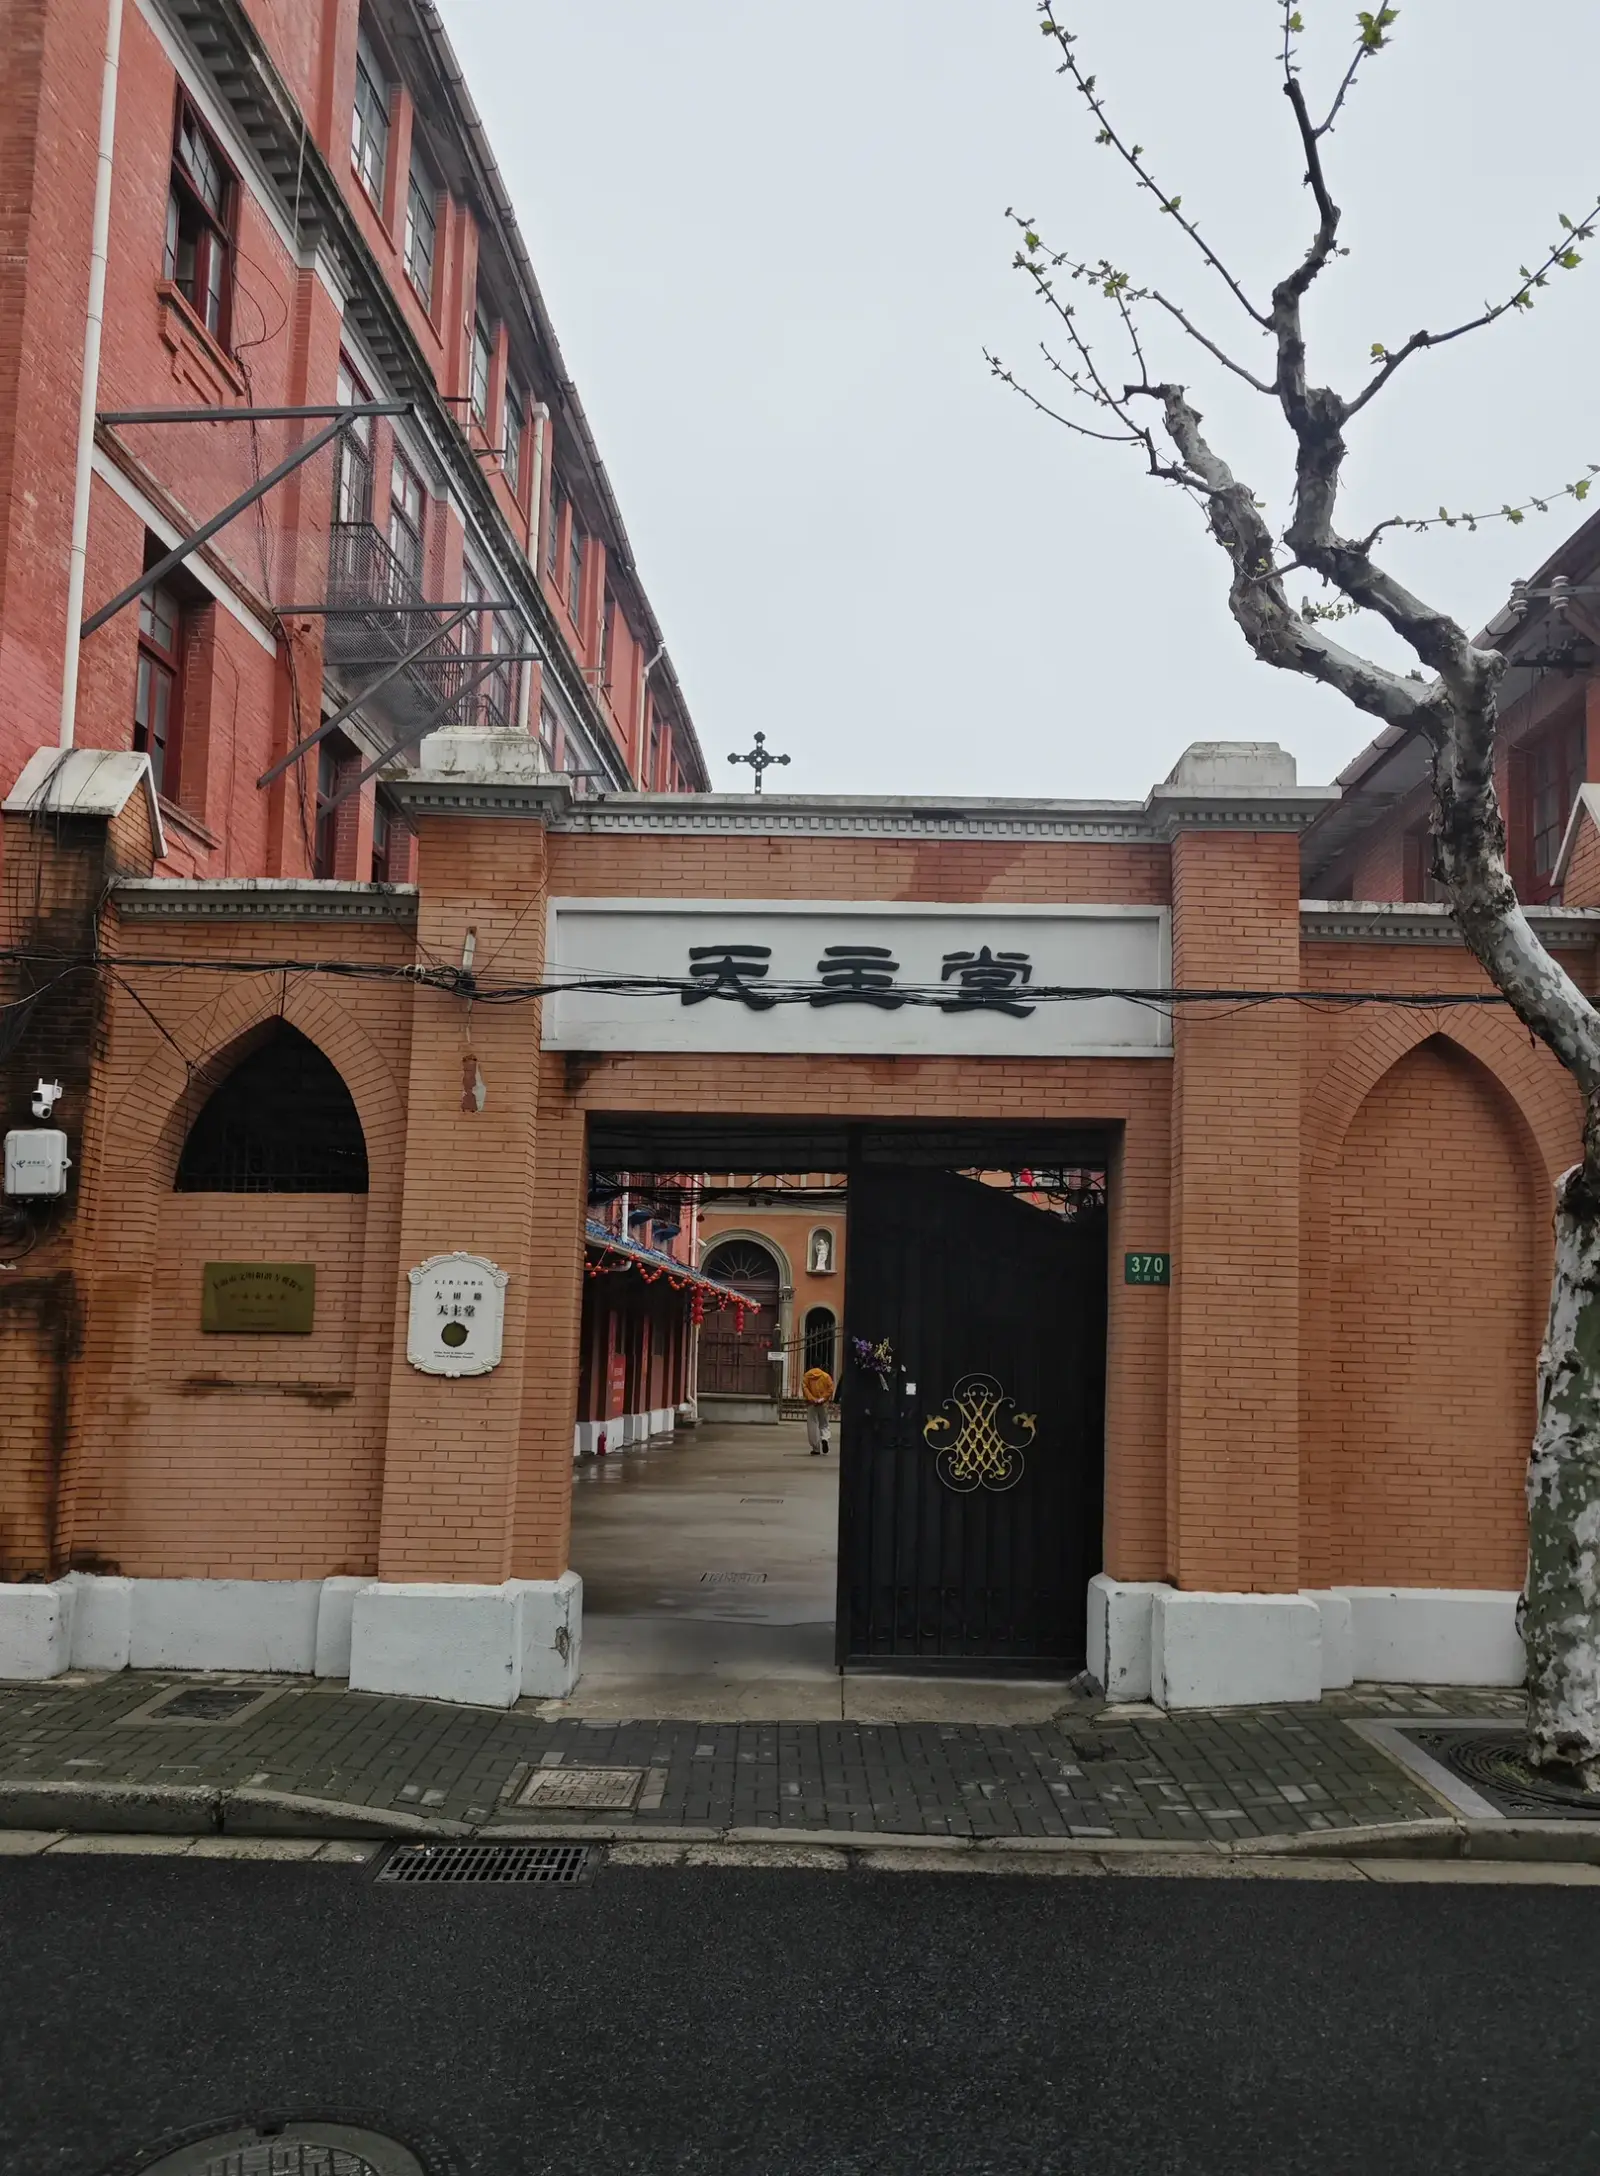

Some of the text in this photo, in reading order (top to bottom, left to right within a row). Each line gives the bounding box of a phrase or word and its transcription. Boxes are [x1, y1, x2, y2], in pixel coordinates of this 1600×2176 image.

[681, 944, 1037, 1018] 天主堂
[1131, 1256, 1163, 1273] 370
[437, 1304, 476, 1317] 天主堂
